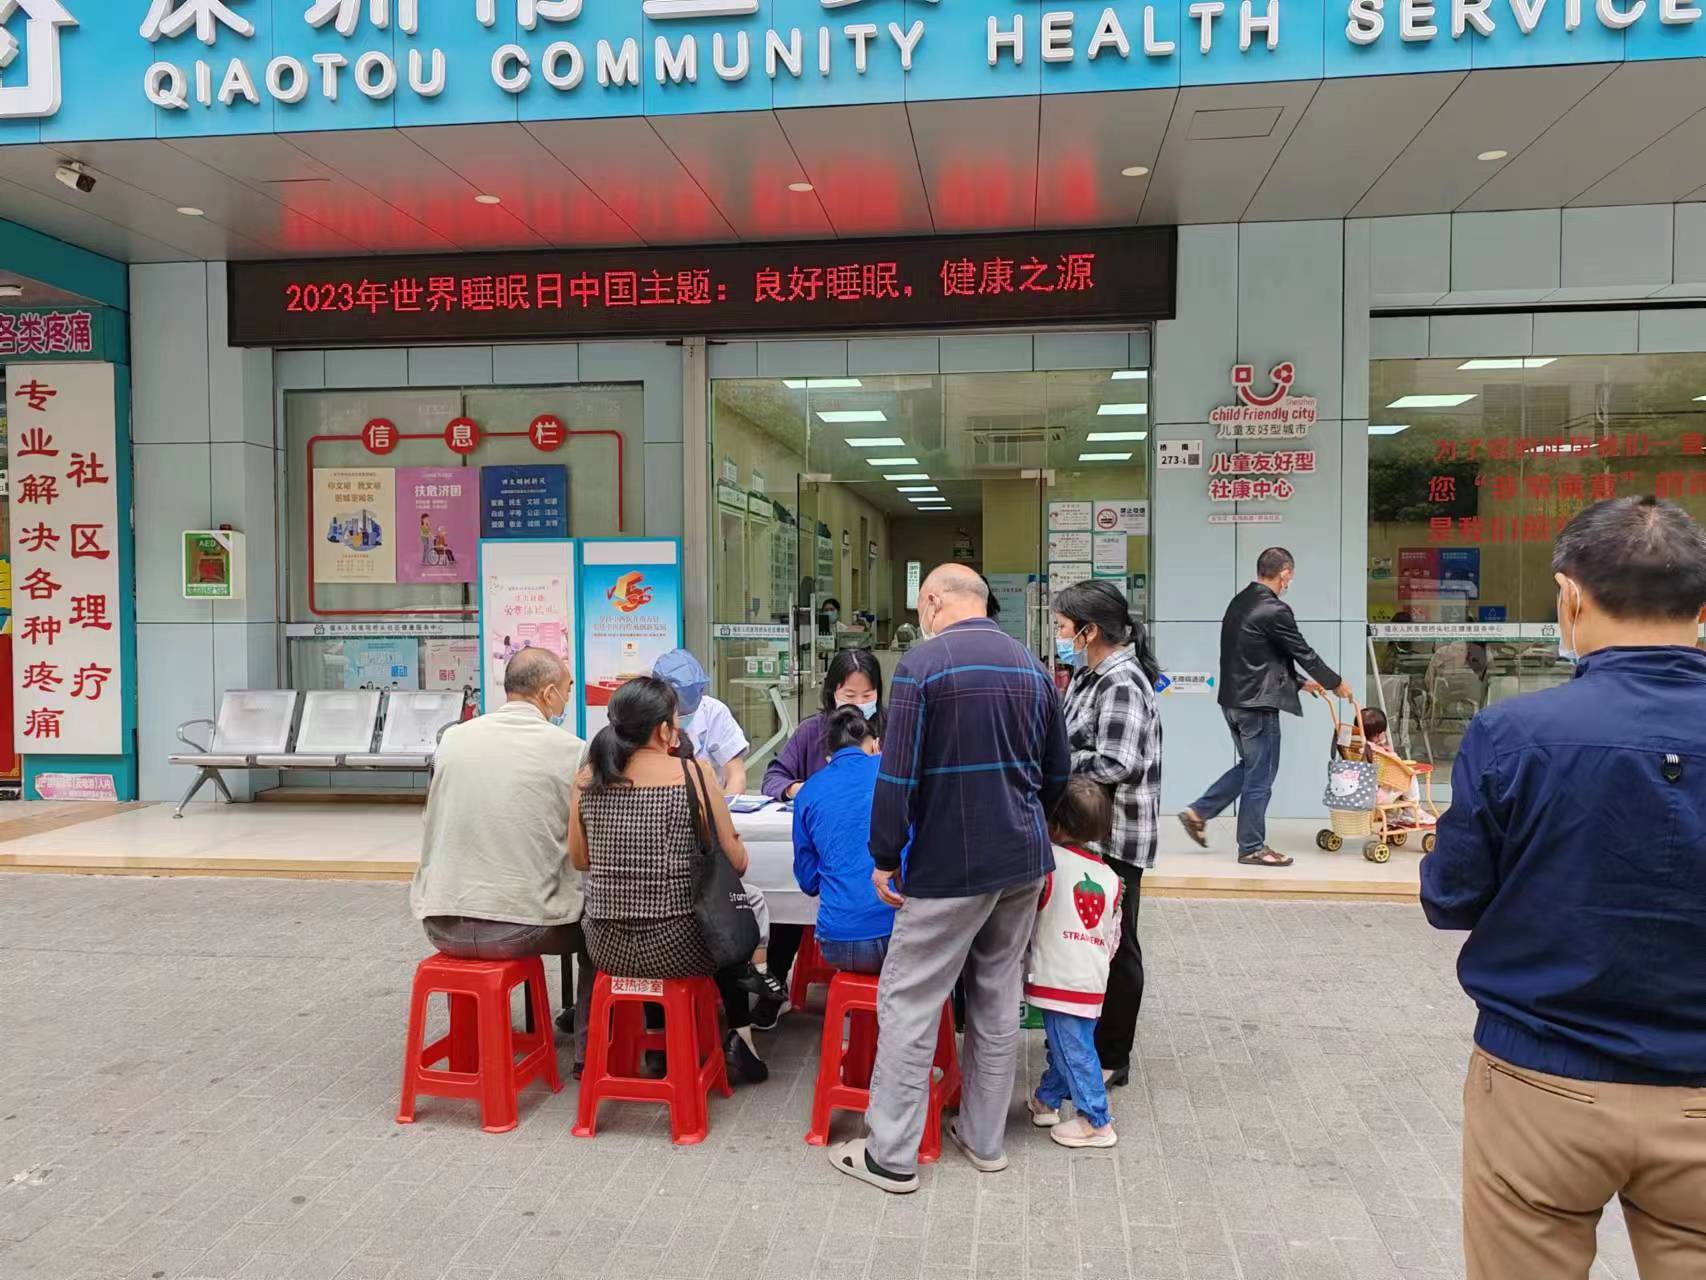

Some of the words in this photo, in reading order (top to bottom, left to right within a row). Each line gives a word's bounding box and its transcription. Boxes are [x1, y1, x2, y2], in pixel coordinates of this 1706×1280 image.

[144, 47, 446, 111] QIAOTOU
[490, 19, 924, 94] COMMUNITY
[986, 0, 1279, 66] HEALTH
[1212, 409, 1241, 421] child
[1291, 406, 1315, 424] city
[1220, 423, 1307, 437] 儿童友好型城市
[1211, 453, 1315, 473] 儿童友好型
[1211, 480, 1293, 499] 社康中心
[15, 379, 64, 739] 专业解决各种疼痛
[66, 452, 113, 702] 社区理疗
